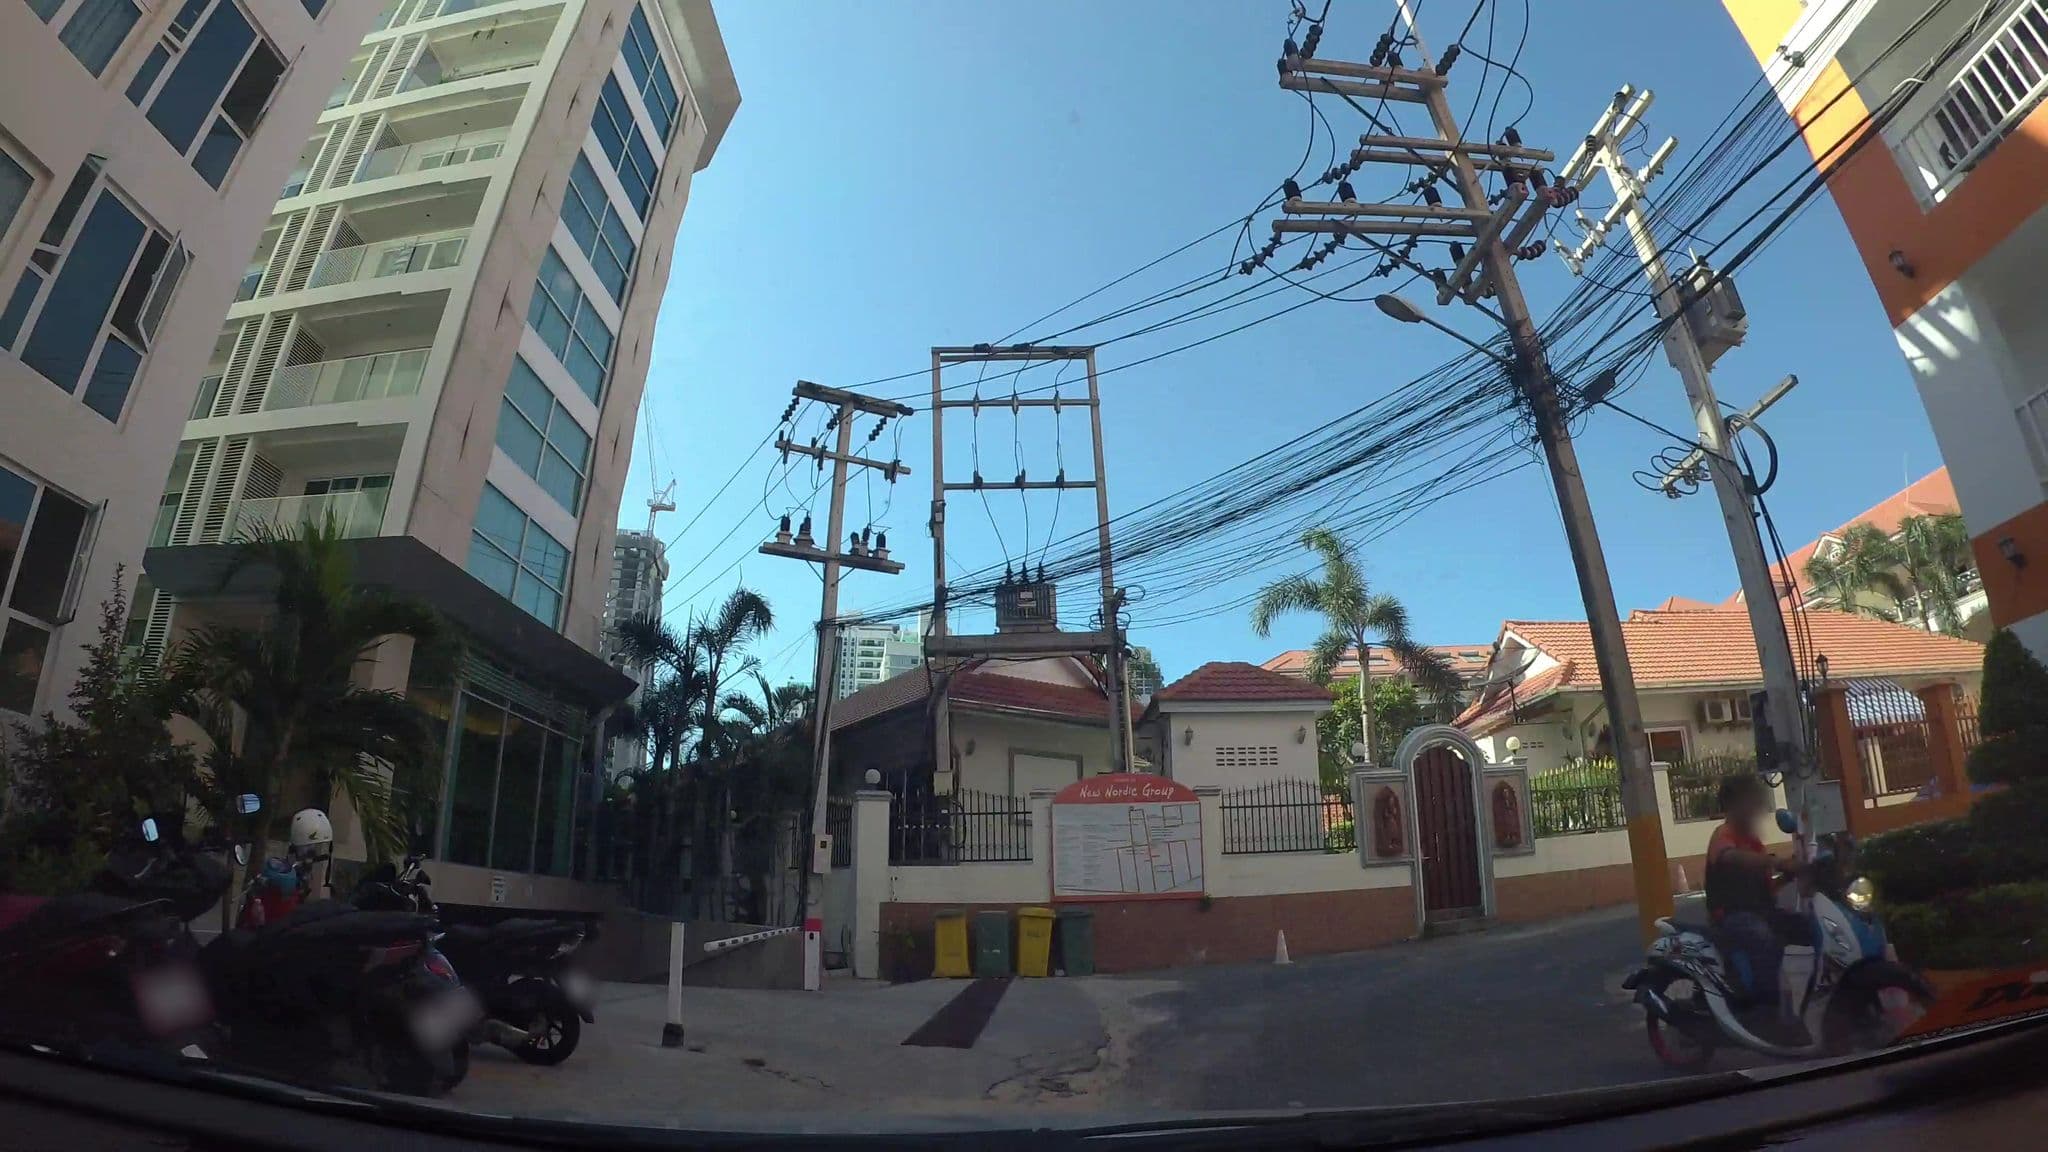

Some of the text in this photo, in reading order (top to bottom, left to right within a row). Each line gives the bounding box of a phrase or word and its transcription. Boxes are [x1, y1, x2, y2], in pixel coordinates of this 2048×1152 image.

[1080, 783, 1174, 799] New Nordic Group
